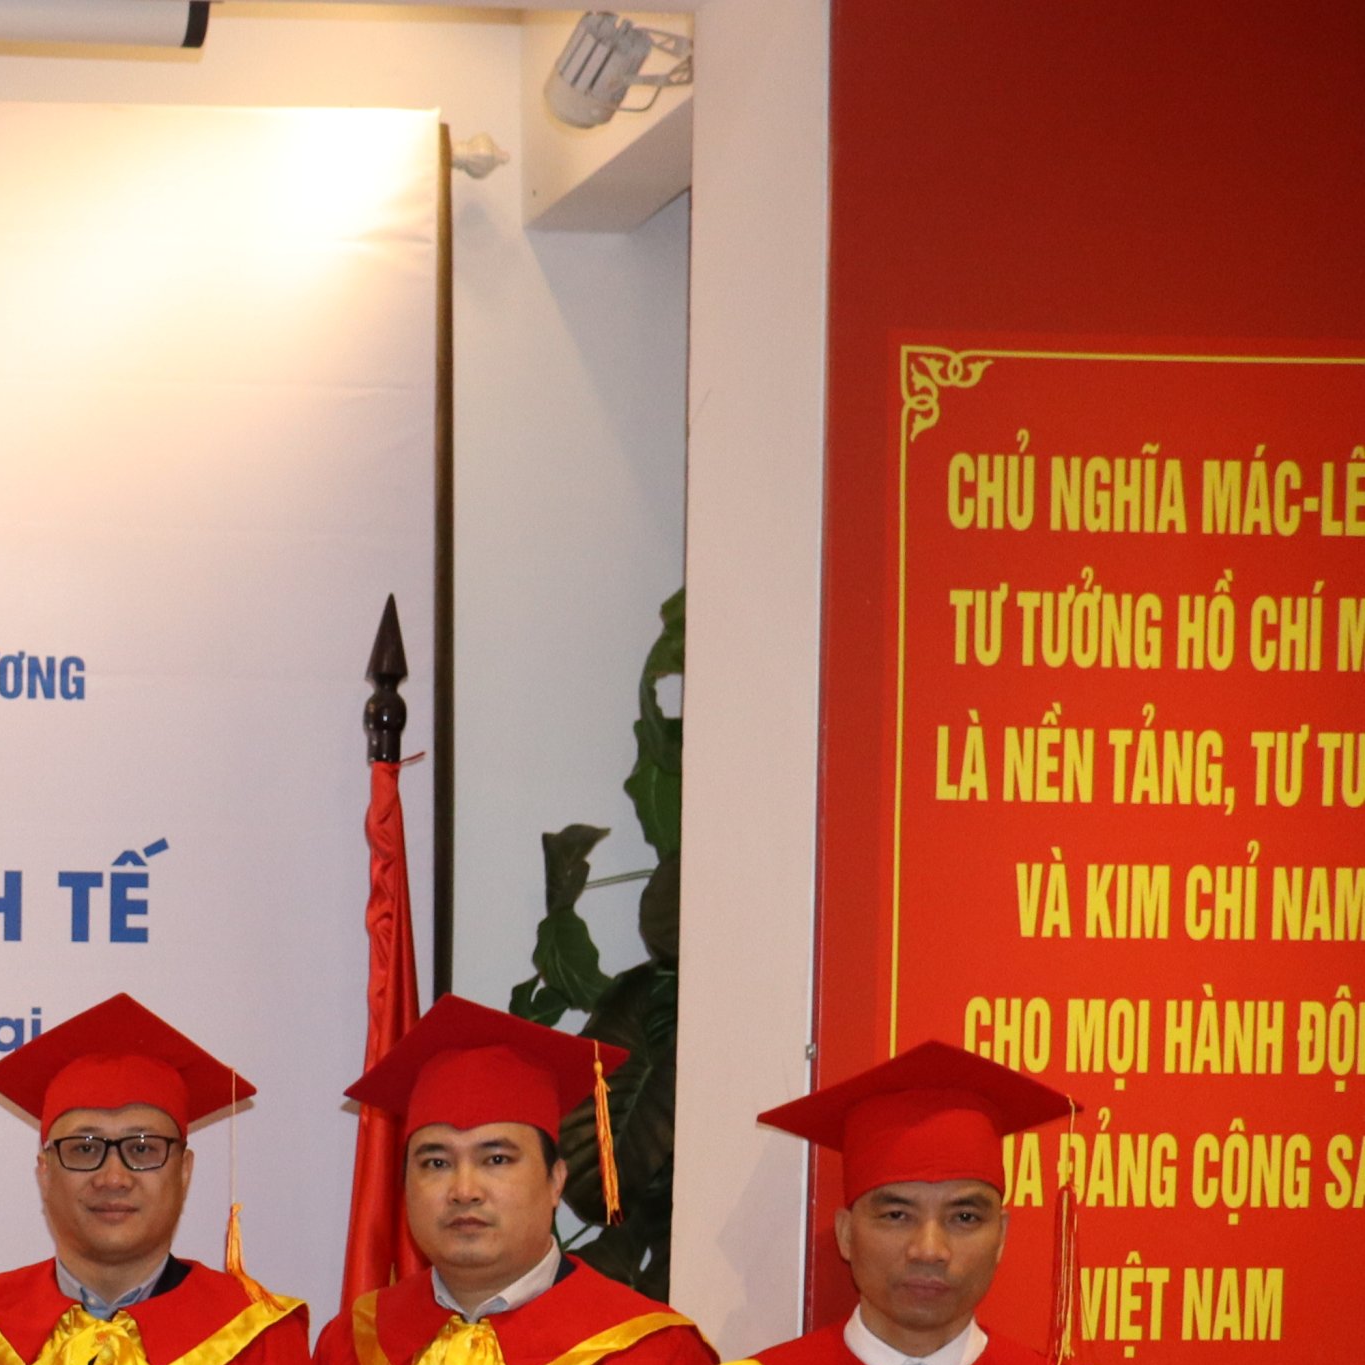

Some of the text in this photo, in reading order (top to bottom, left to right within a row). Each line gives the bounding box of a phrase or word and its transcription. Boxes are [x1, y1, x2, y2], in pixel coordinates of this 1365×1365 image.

[949, 430, 1365, 535] CHỦ NGHĨA MÁC-LÊ
[950, 584, 1008, 665] TƯ
[1018, 567, 1161, 669] TƯỞNG
[1178, 570, 1234, 670] HỒ
[1251, 582, 1323, 671] CHÍ
[936, 710, 987, 800] LÀ
[1004, 703, 1094, 802] NỀN
[1109, 704, 1234, 814] TẢNG,
[1252, 725, 1309, 806] TƯ
[58, 837, 169, 944] TẾ
[1017, 841, 1365, 940] VÀ KIM CHỈ NAM
[964, 984, 1365, 1091] CHO MỌI HÀNH ĐỘ
[1058, 1108, 1177, 1208] ĐẢNG
[1193, 1118, 1310, 1224] CỘNG
[1080, 1252, 1283, 1357] VIỆT NAM
